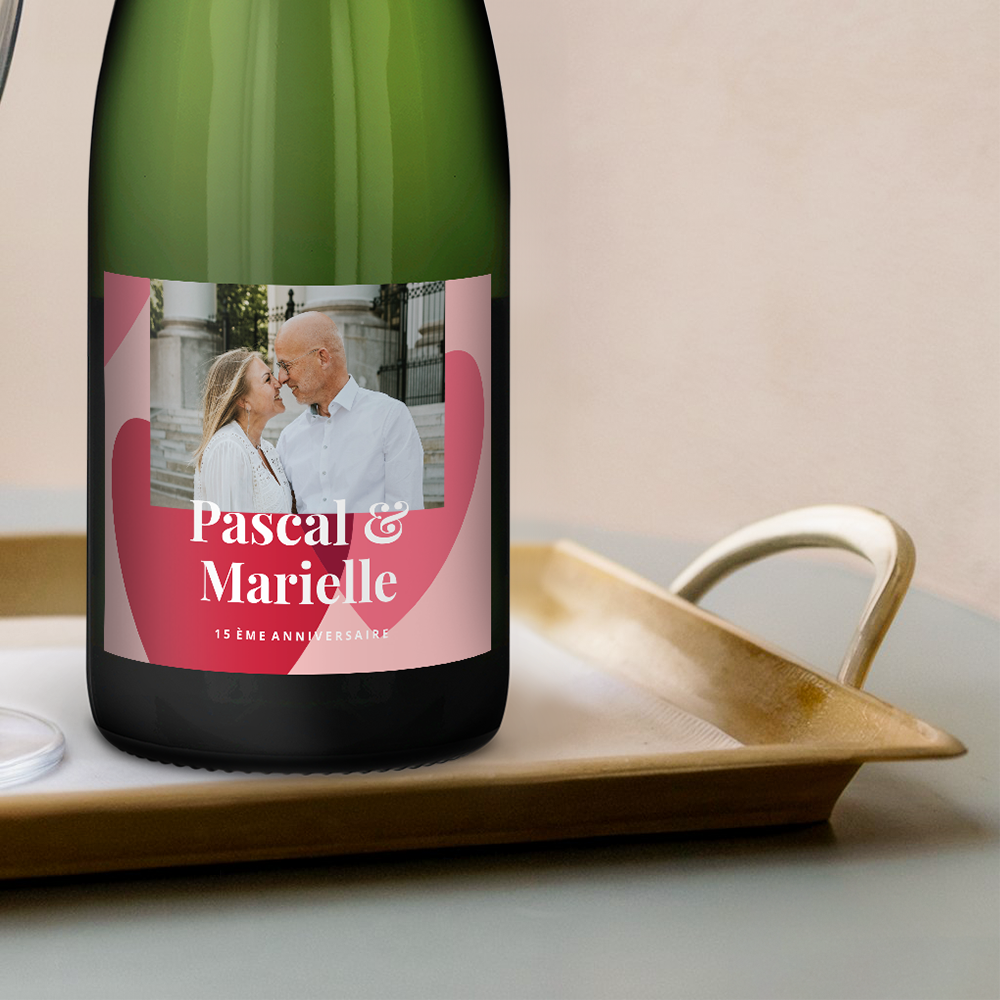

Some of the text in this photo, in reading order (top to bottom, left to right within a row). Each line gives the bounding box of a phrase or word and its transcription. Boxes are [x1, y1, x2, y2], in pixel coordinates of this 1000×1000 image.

[190, 498, 410, 546] Pascal &
[200, 557, 398, 606] Marielle
[214, 626, 390, 642] 15 ÈME ANNIVERSAIRE
